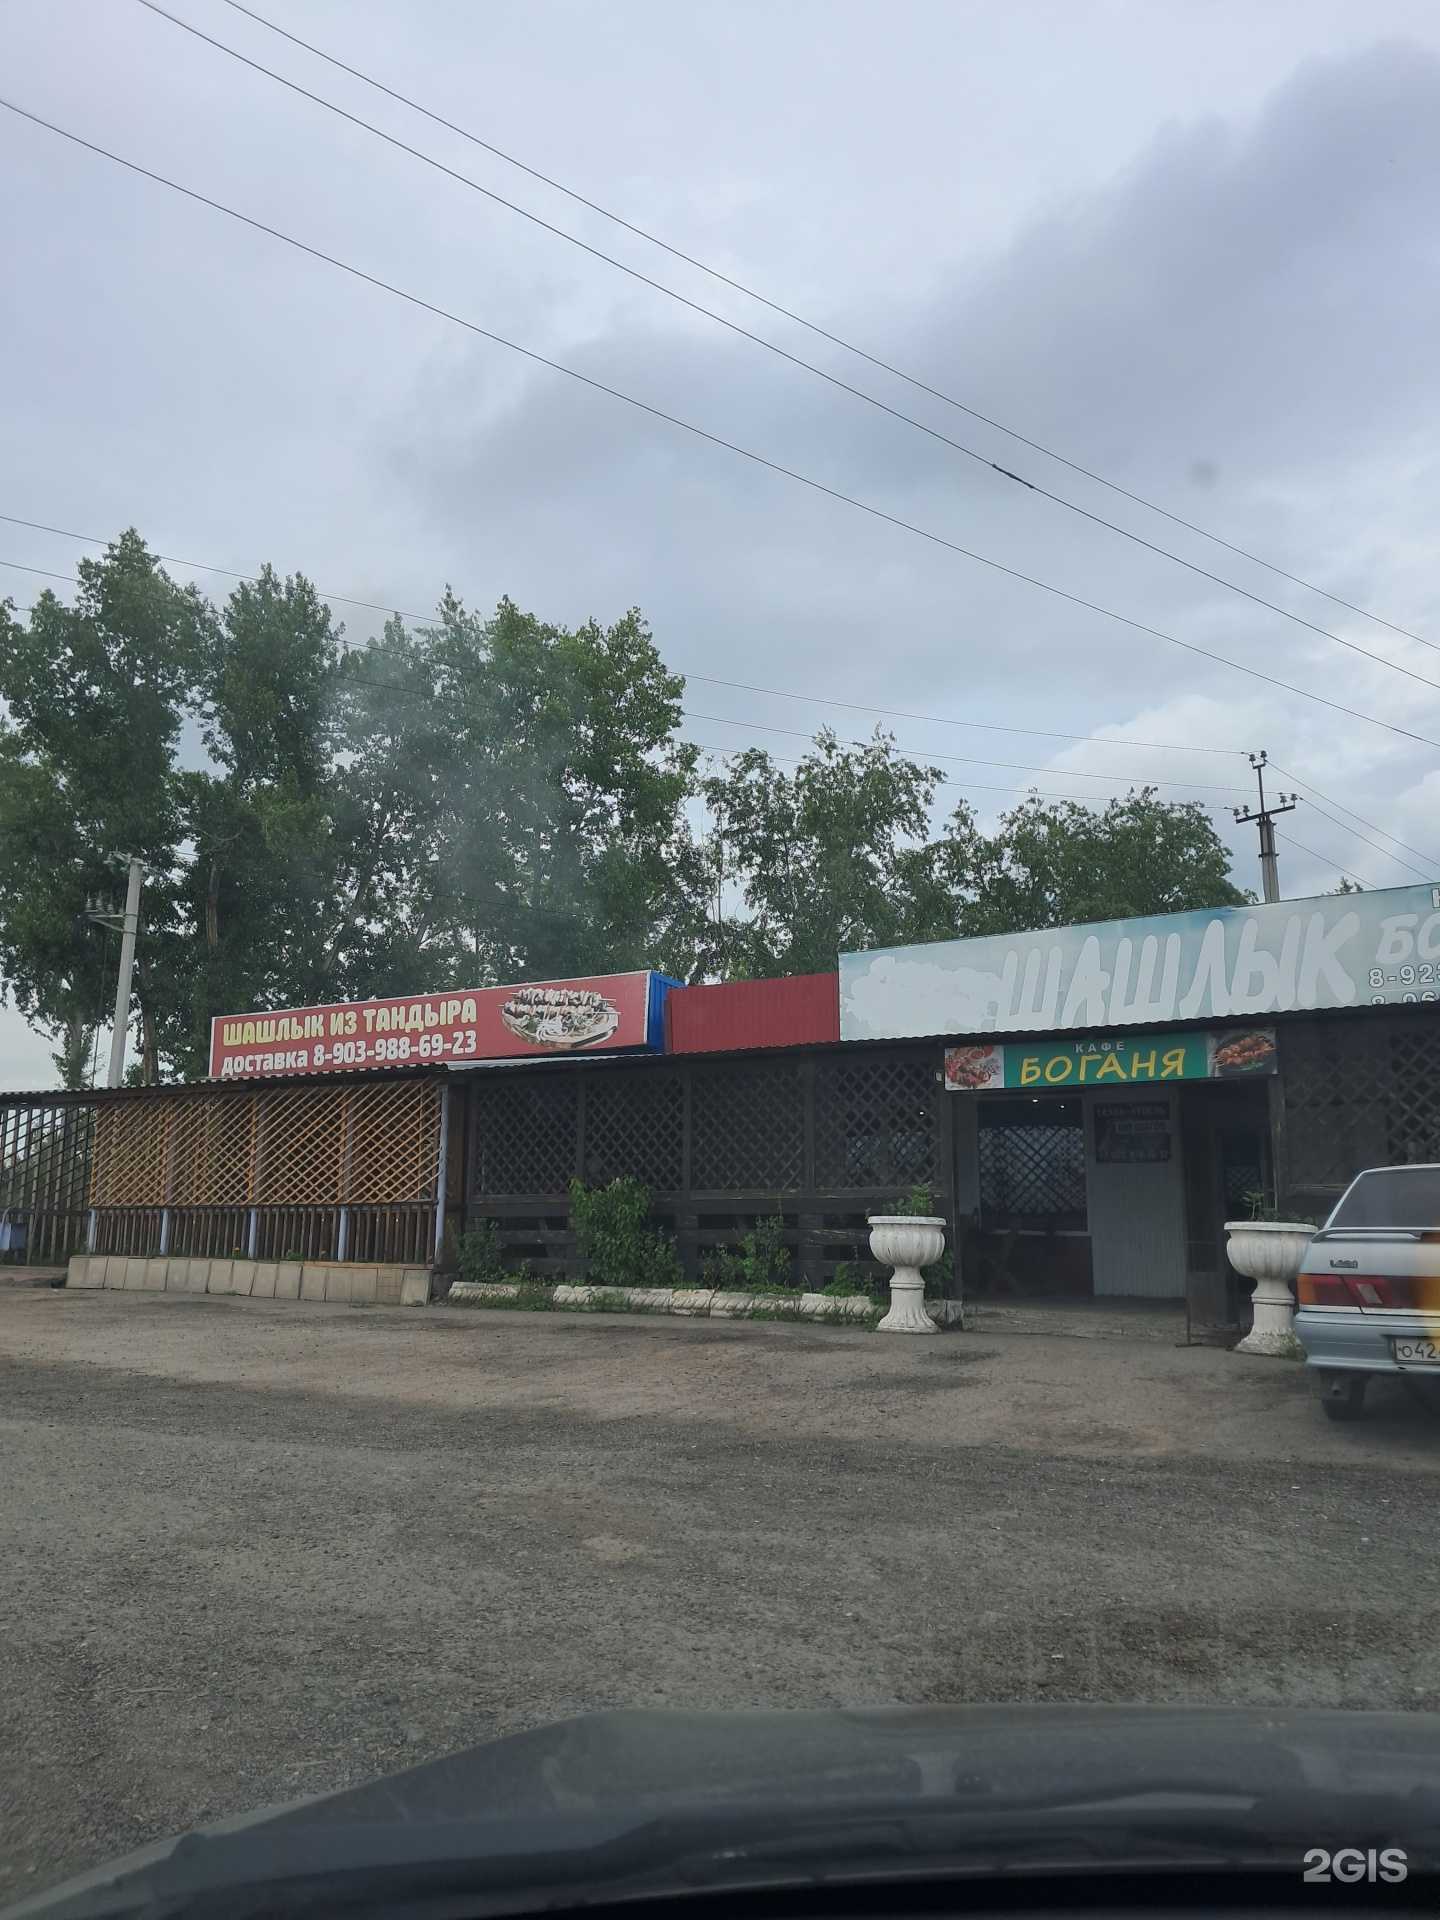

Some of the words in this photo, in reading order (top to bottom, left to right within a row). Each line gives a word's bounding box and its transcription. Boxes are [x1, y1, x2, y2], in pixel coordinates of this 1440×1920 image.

[991, 911, 1361, 1030] ШАШЛЫК
[1368, 963, 1440, 988] 8-92
[223, 1014, 325, 1047] ШАШЛЫК
[330, 1011, 358, 1036] ИЗ
[363, 998, 477, 1034] ТАНДЫРА
[221, 1049, 309, 1077] доставка
[313, 1030, 477, 1067] 8-903-988-69-23
[1020, 1048, 1186, 1086] БОГАНЯ
[1075, 1041, 1126, 1053] КАФЕ
